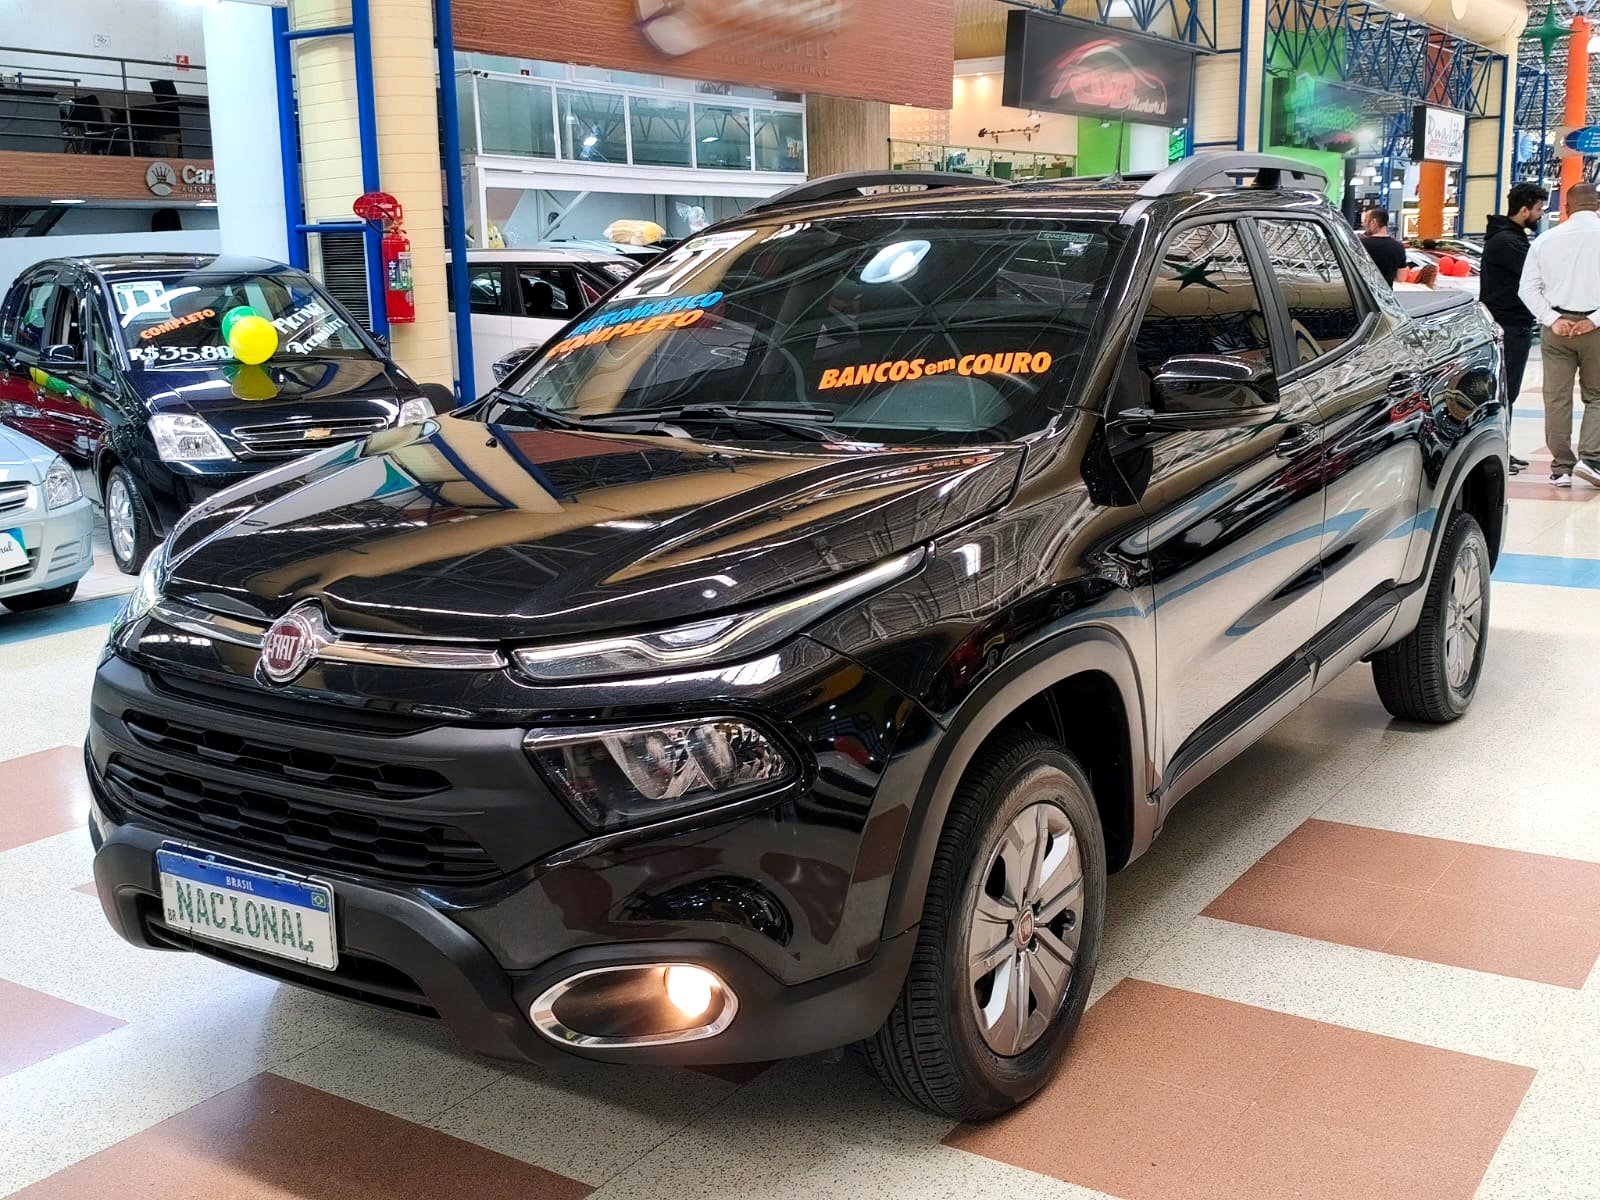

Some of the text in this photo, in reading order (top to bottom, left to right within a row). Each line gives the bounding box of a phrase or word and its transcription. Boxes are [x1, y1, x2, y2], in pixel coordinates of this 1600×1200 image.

[140, 308, 216, 339] COMPLETO
[545, 309, 705, 358] COMPLETO
[127, 344, 235, 361] R$35.80
[818, 351, 1052, 390] BANCOS em COURO
[270, 633, 299, 661] FIAT
[225, 875, 254, 892] BRASIL
[167, 908, 178, 923] BR
[175, 880, 314, 953] NACIONAL
